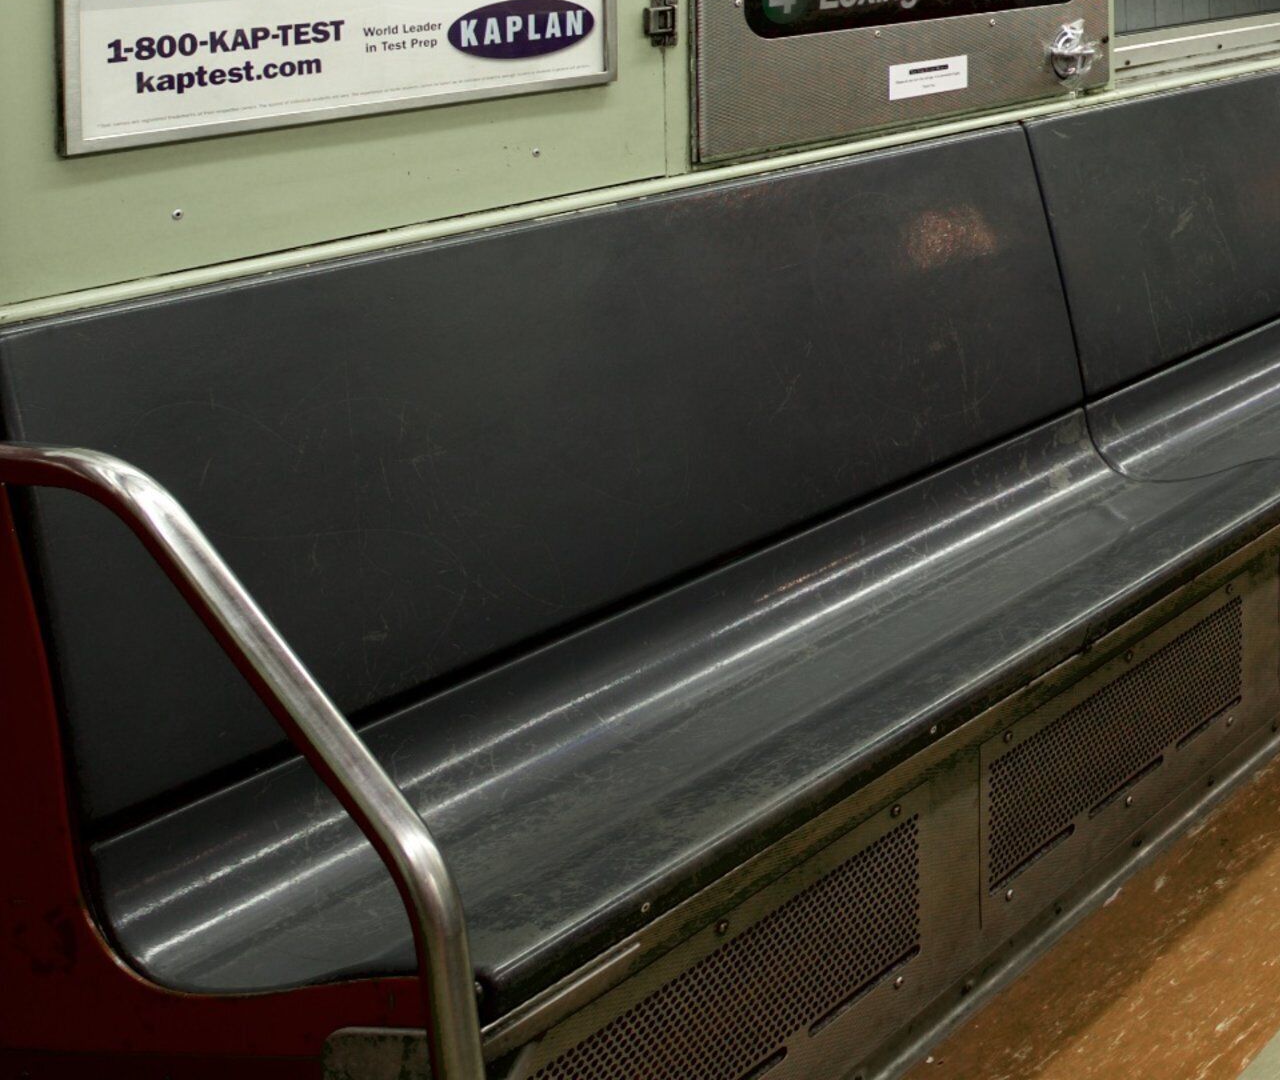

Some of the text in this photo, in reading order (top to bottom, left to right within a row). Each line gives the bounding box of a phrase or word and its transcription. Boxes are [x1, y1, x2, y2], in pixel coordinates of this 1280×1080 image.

[106, 19, 346, 64] 1-800-KAP-TEST
[362, 21, 443, 38] World Leader
[365, 36, 438, 54] in Test Prep
[459, 9, 585, 48] KAPLAN
[135, 57, 323, 95] kaptest.com
